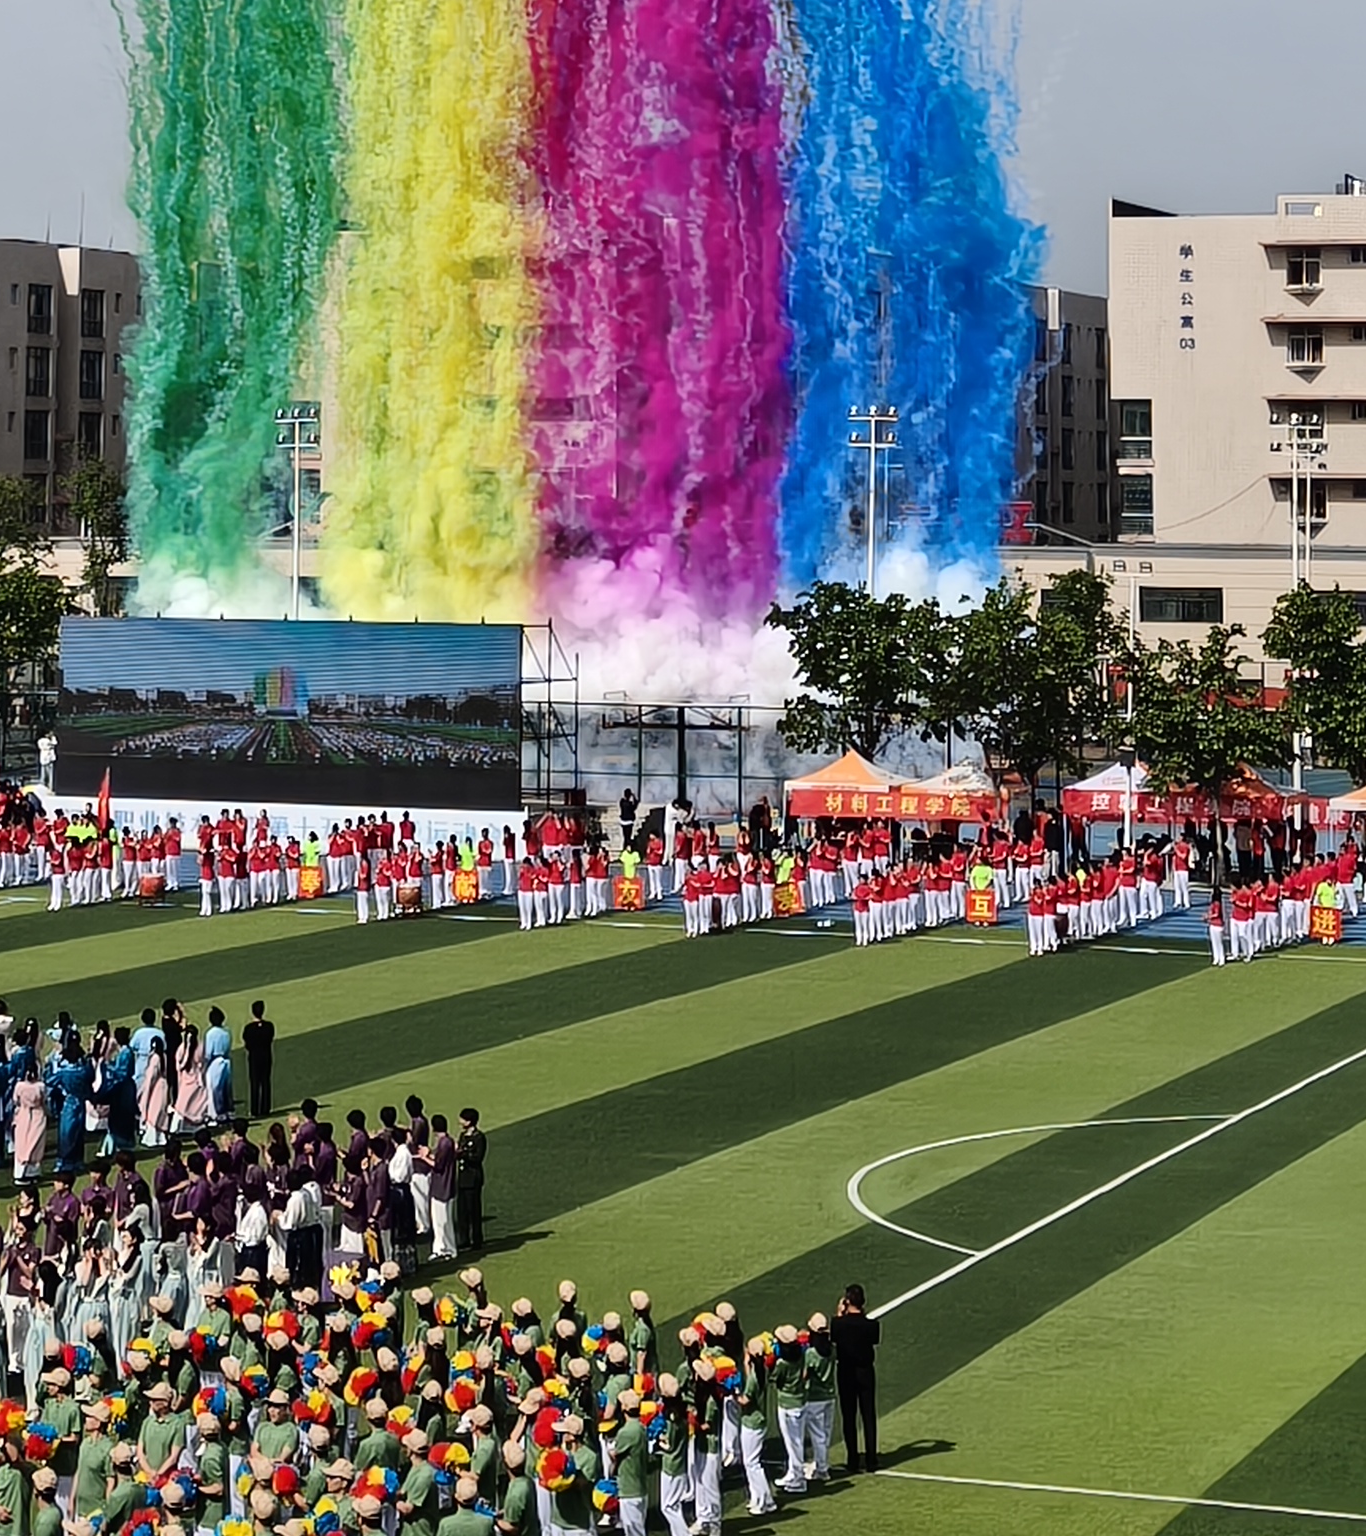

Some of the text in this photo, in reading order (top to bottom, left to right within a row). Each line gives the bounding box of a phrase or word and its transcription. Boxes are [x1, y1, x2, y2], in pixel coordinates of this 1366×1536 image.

[825, 792, 971, 816] 材料工程学院
[618, 880, 640, 905] 友
[971, 895, 993, 917] 互
[1312, 907, 1336, 936] 进
